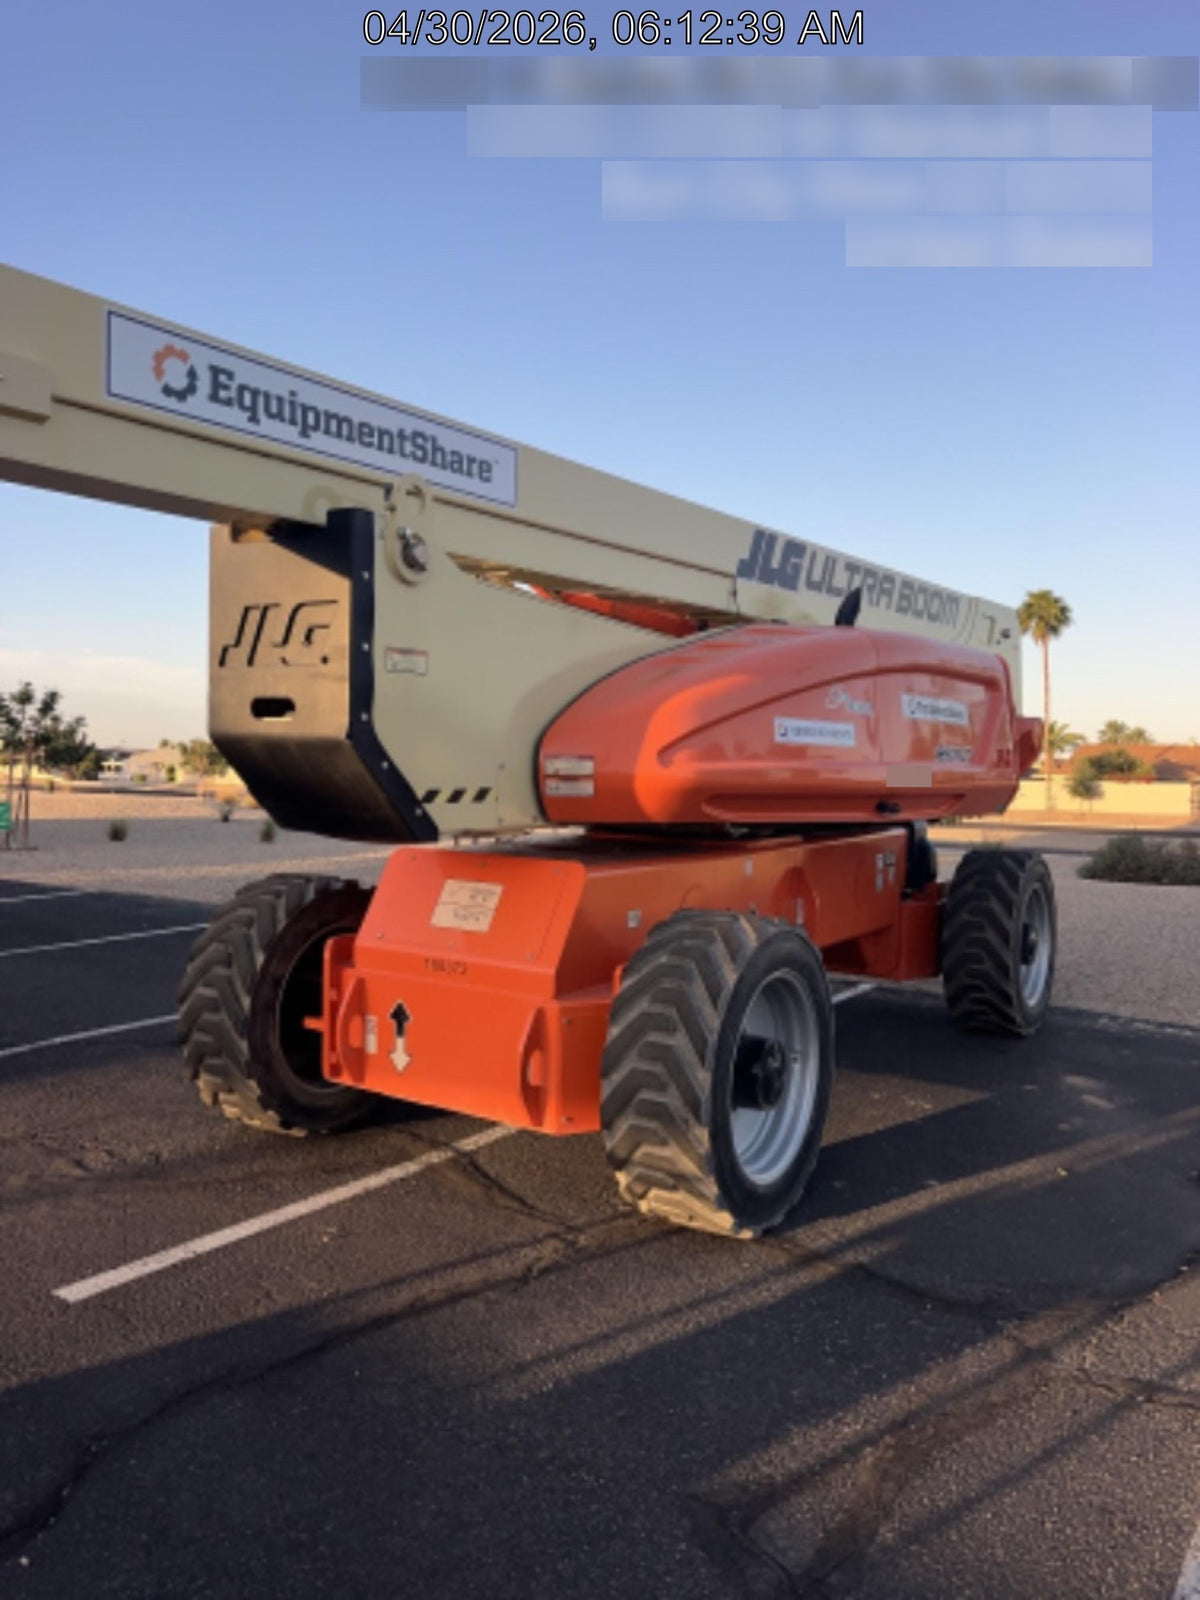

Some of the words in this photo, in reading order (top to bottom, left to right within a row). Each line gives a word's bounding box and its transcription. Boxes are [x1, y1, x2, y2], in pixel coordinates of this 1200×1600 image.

[207, 364, 494, 484] EquipmentShare
[736, 529, 808, 591] JLG
[805, 551, 896, 610] ULTRA
[895, 574, 961, 628] BOOM
